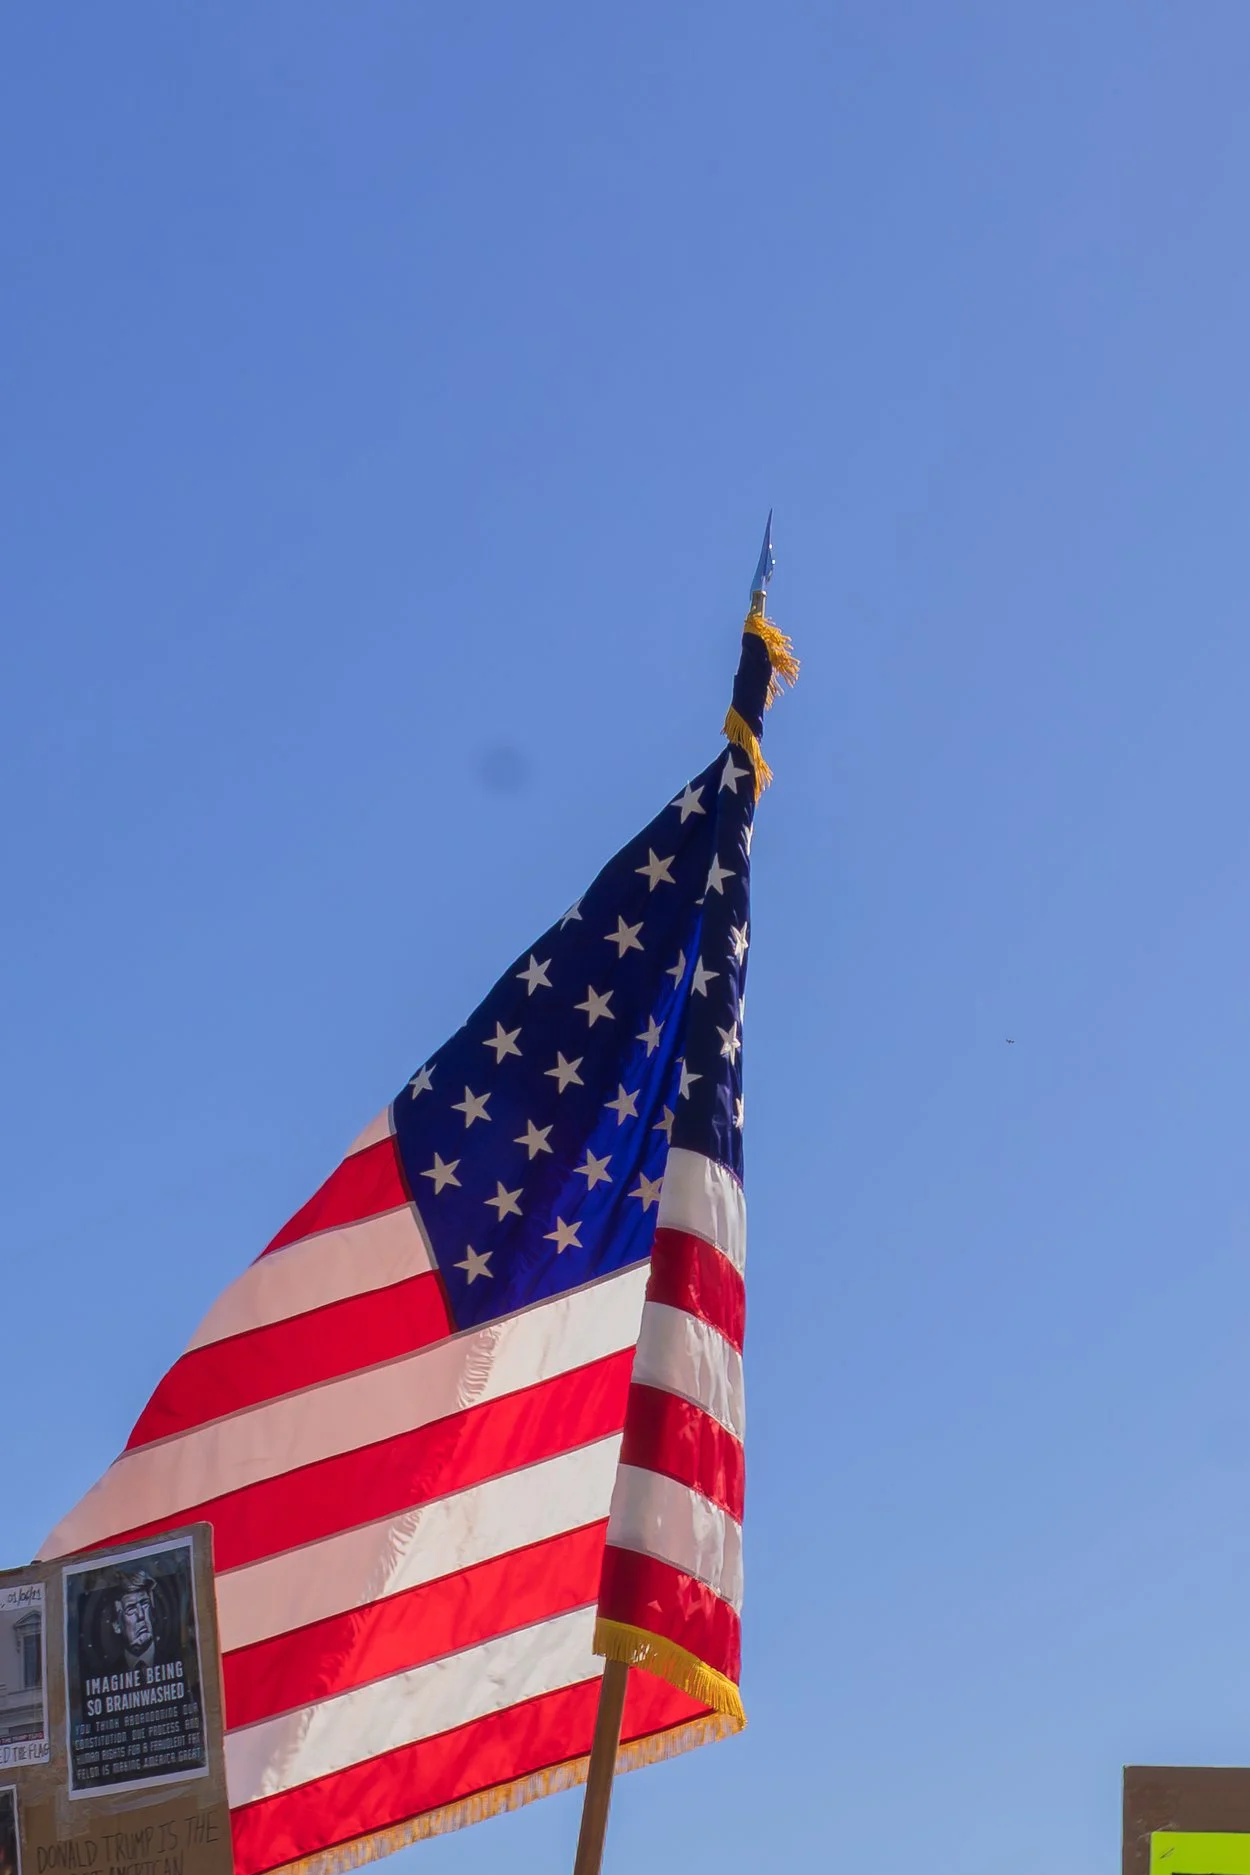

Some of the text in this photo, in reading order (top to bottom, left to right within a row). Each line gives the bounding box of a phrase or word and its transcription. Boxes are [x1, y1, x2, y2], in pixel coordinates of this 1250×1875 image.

[86, 1661, 184, 1696] IMAGINE BEING
[87, 1682, 184, 1716] SO BRAINWASHED
[37, 1810, 220, 1874] DONALD TRUMP IS THE
